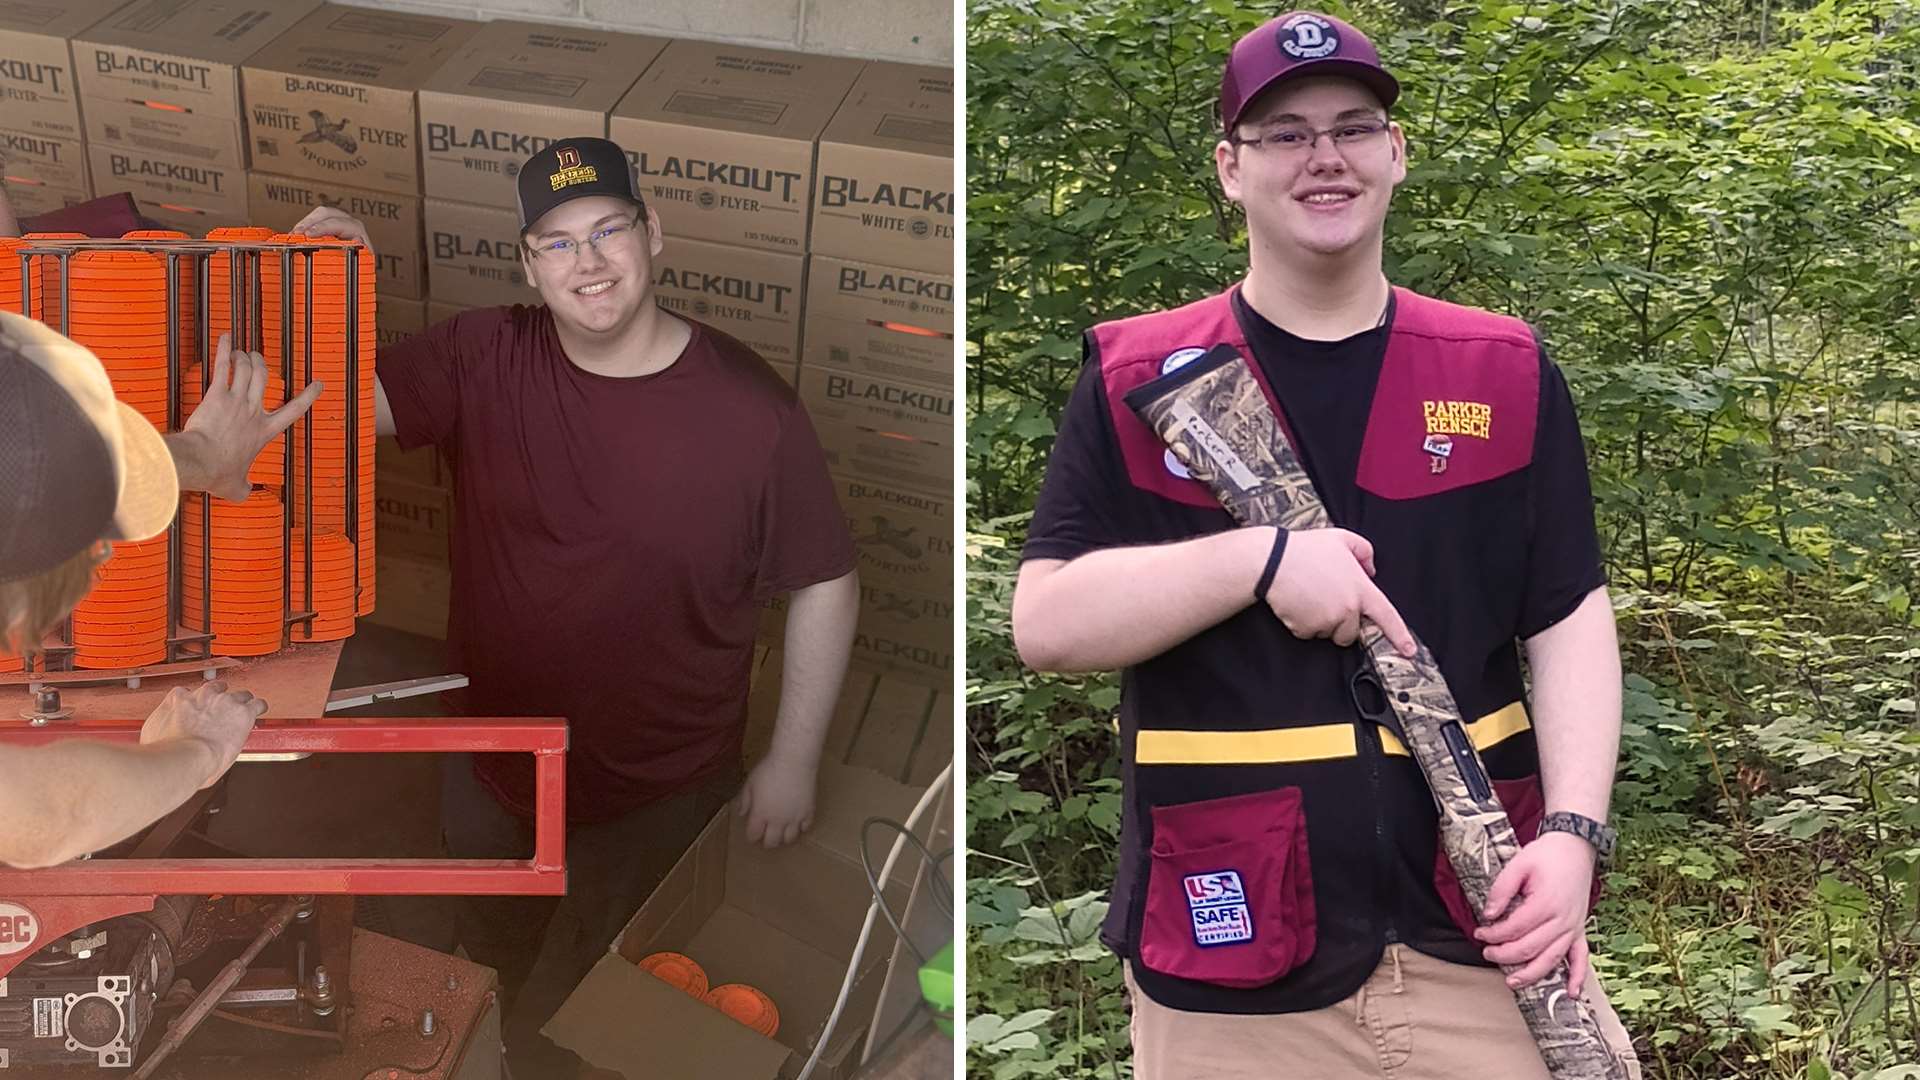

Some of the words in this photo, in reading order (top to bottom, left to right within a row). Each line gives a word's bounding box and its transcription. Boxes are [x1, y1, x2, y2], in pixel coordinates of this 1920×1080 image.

[1295, 23, 1323, 46] D
[253, 110, 300, 131] WHITE
[359, 127, 408, 148] FLYER
[427, 122, 558, 155] BLACKO
[302, 146, 367, 171] SPORTING
[463, 157, 500, 174] WHITE
[556, 147, 581, 171] D
[266, 184, 314, 206] WHITE
[352, 197, 401, 220] FLYER
[654, 186, 693, 203] WHITE
[720, 196, 760, 212] FLYER
[862, 213, 905, 231] WHITE
[935, 224, 953, 239] FL
[433, 231, 521, 263] BLAC
[467, 264, 504, 280] WHITE
[715, 305, 752, 322] FLYER
[1422, 400, 1491, 421] PARKER
[1425, 416, 1490, 439] RENSCH
[1195, 907, 1240, 924] SAFE
[1199, 931, 1244, 942] CERTIFIED
